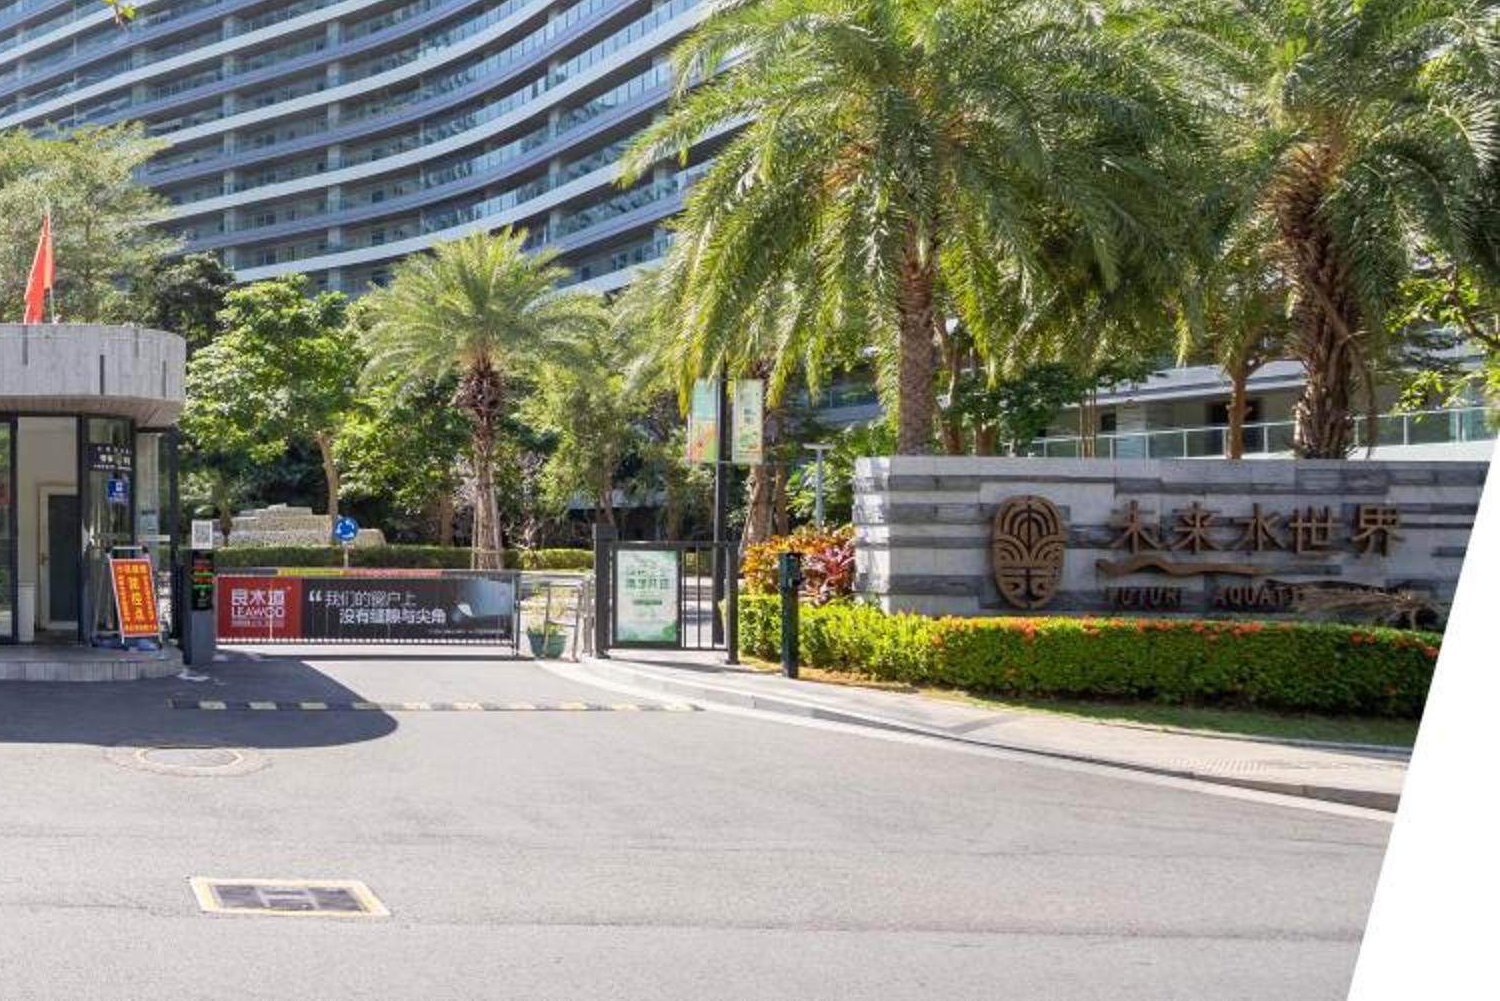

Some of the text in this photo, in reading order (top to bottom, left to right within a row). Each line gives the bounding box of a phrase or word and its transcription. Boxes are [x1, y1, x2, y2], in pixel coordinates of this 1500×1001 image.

[1107, 500, 1406, 558] 未来水世界
